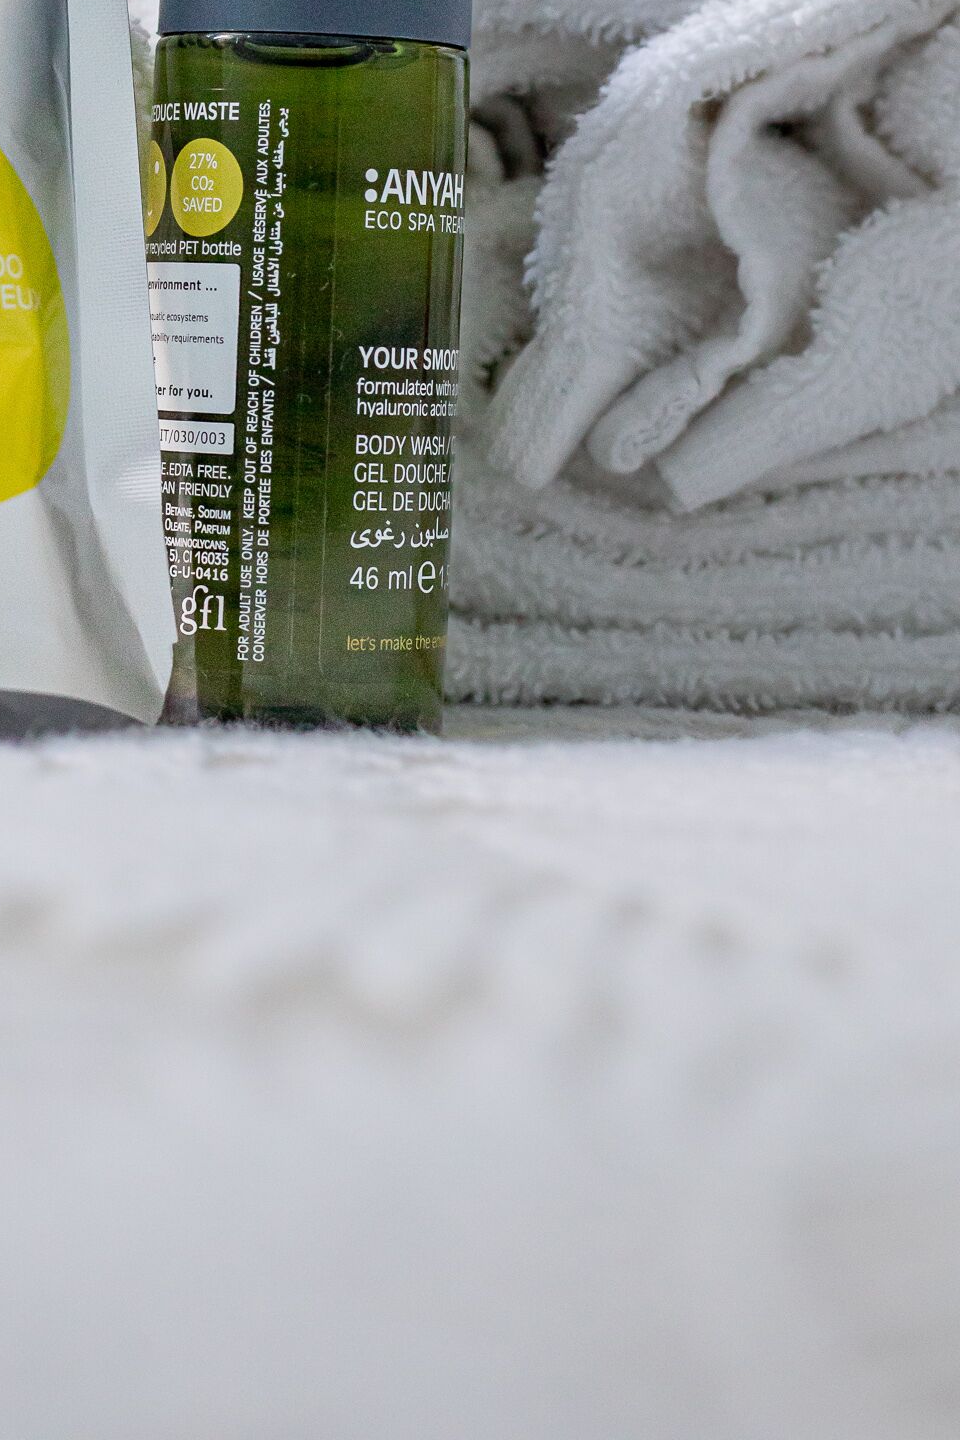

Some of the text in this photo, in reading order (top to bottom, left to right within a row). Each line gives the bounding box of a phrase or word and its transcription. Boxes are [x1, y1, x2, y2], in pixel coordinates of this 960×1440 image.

[184, 101, 240, 121] WASTE
[257, 99, 271, 156] ADULTES.
[190, 153, 218, 169] 27%
[256, 159, 268, 185] AUX
[183, 197, 222, 213] SAVED
[365, 210, 402, 230] ECO
[408, 212, 435, 232] SPA
[179, 240, 199, 255] PET
[202, 240, 242, 256] bottle
[251, 247, 265, 286] USAGE
[148, 278, 202, 291] environment
[248, 291, 262, 301] /
[166, 312, 209, 324] ecosystems
[171, 333, 225, 346] requirements
[249, 306, 262, 365] CHILDREN
[359, 346, 418, 370] YOUR
[248, 370, 260, 386] OF
[357, 377, 433, 396] formulated
[168, 384, 213, 400] for you.
[246, 391, 259, 432] REACH
[260, 390, 275, 446] ENFANTS
[356, 398, 428, 418] hyaluronic
[430, 399, 447, 417] acid
[245, 437, 258, 454] OF
[355, 435, 406, 456] BODY
[411, 436, 445, 456] WASH
[197, 465, 231, 480] FREE.
[244, 459, 257, 482] OUT
[259, 450, 272, 473] DES
[354, 462, 388, 483] GEL
[394, 463, 446, 484] DOUCHE
[178, 482, 232, 498] FRIENDLY
[352, 490, 387, 511] GEL
[393, 491, 413, 512] DE
[243, 488, 256, 519] KEEP
[257, 478, 271, 525] PORTÉE
[241, 525, 255, 560] ONLY.
[257, 529, 270, 546] DE
[194, 550, 230, 566] 16035
[256, 551, 269, 584] HORS
[240, 565, 252, 588] USE
[350, 566, 379, 590] 46
[388, 565, 413, 590] ml
[238, 593, 251, 632] ADULT
[253, 590, 267, 662] CONSERVER
[237, 636, 250, 661] FOR
[346, 635, 376, 651] let's
[380, 635, 413, 651] make
[415, 634, 431, 650] the
